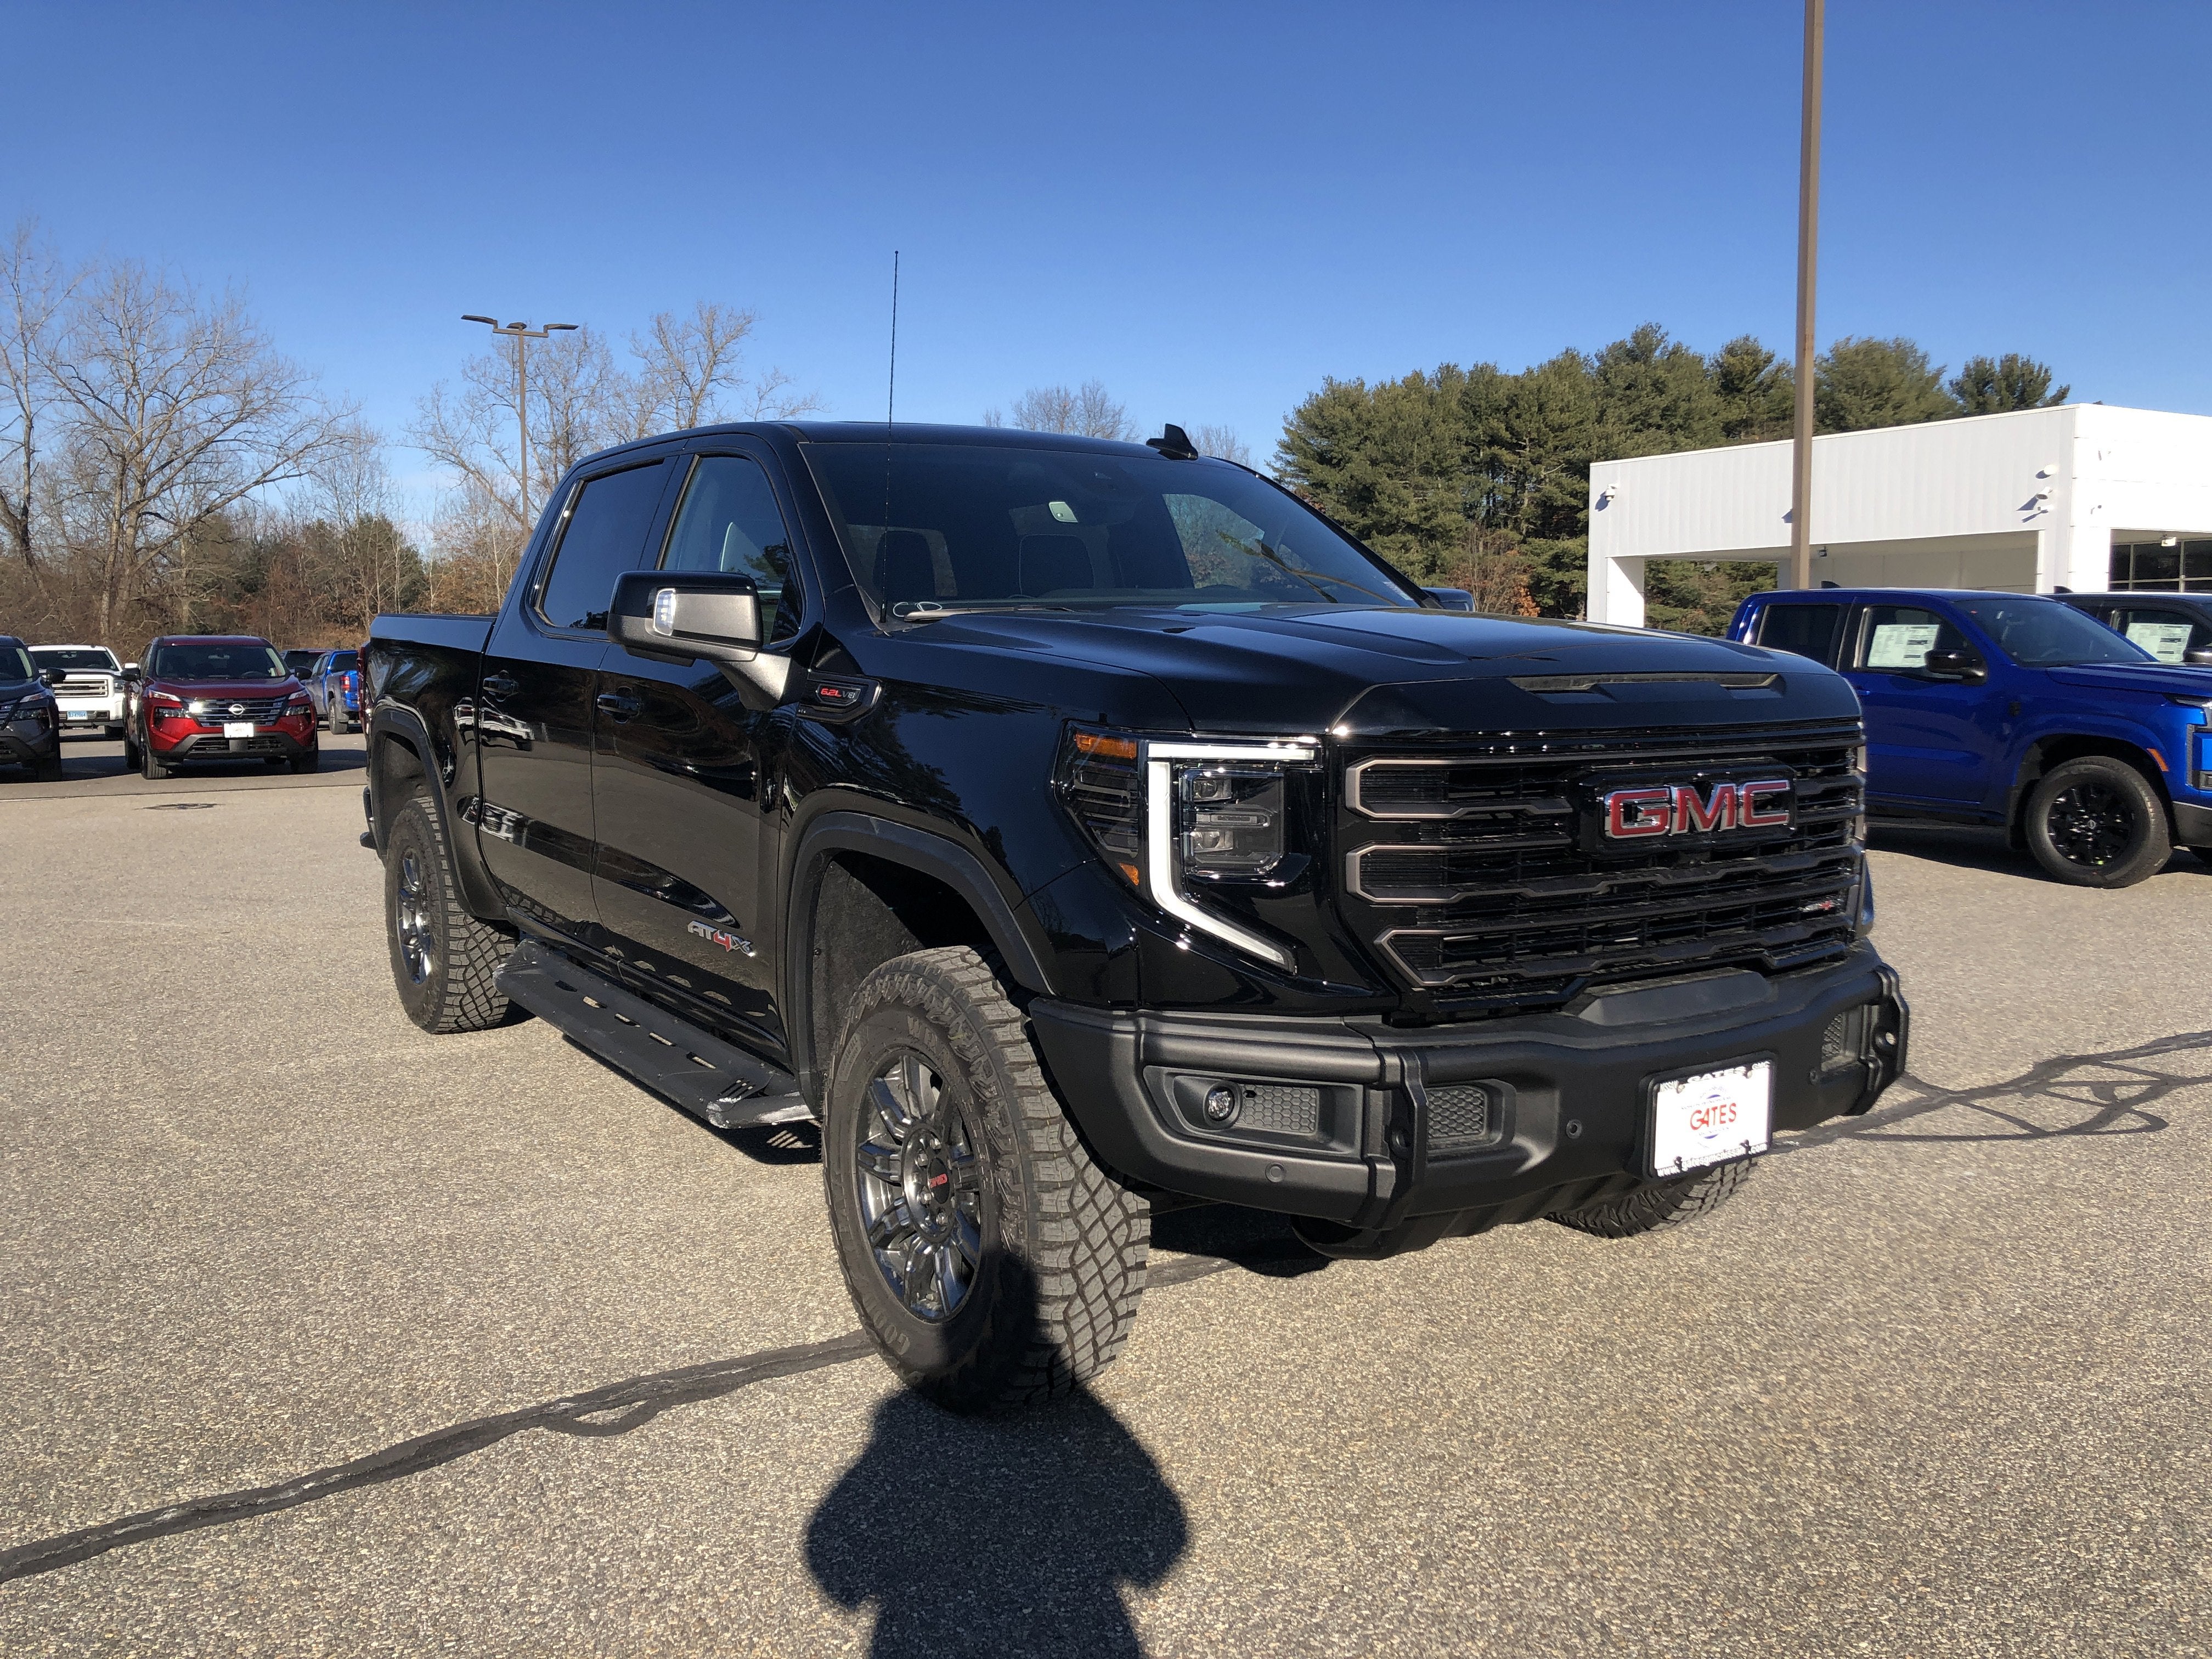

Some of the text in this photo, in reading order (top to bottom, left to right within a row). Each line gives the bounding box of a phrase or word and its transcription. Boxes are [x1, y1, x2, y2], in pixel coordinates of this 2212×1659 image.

[842, 690, 856, 699] V8
[1604, 780, 1791, 839] GMC
[687, 920, 757, 957] AT4X
[1687, 1066, 1747, 1084] GATES
[1752, 1060, 1770, 1070] GMC
[1690, 1102, 1737, 1131] GATES
